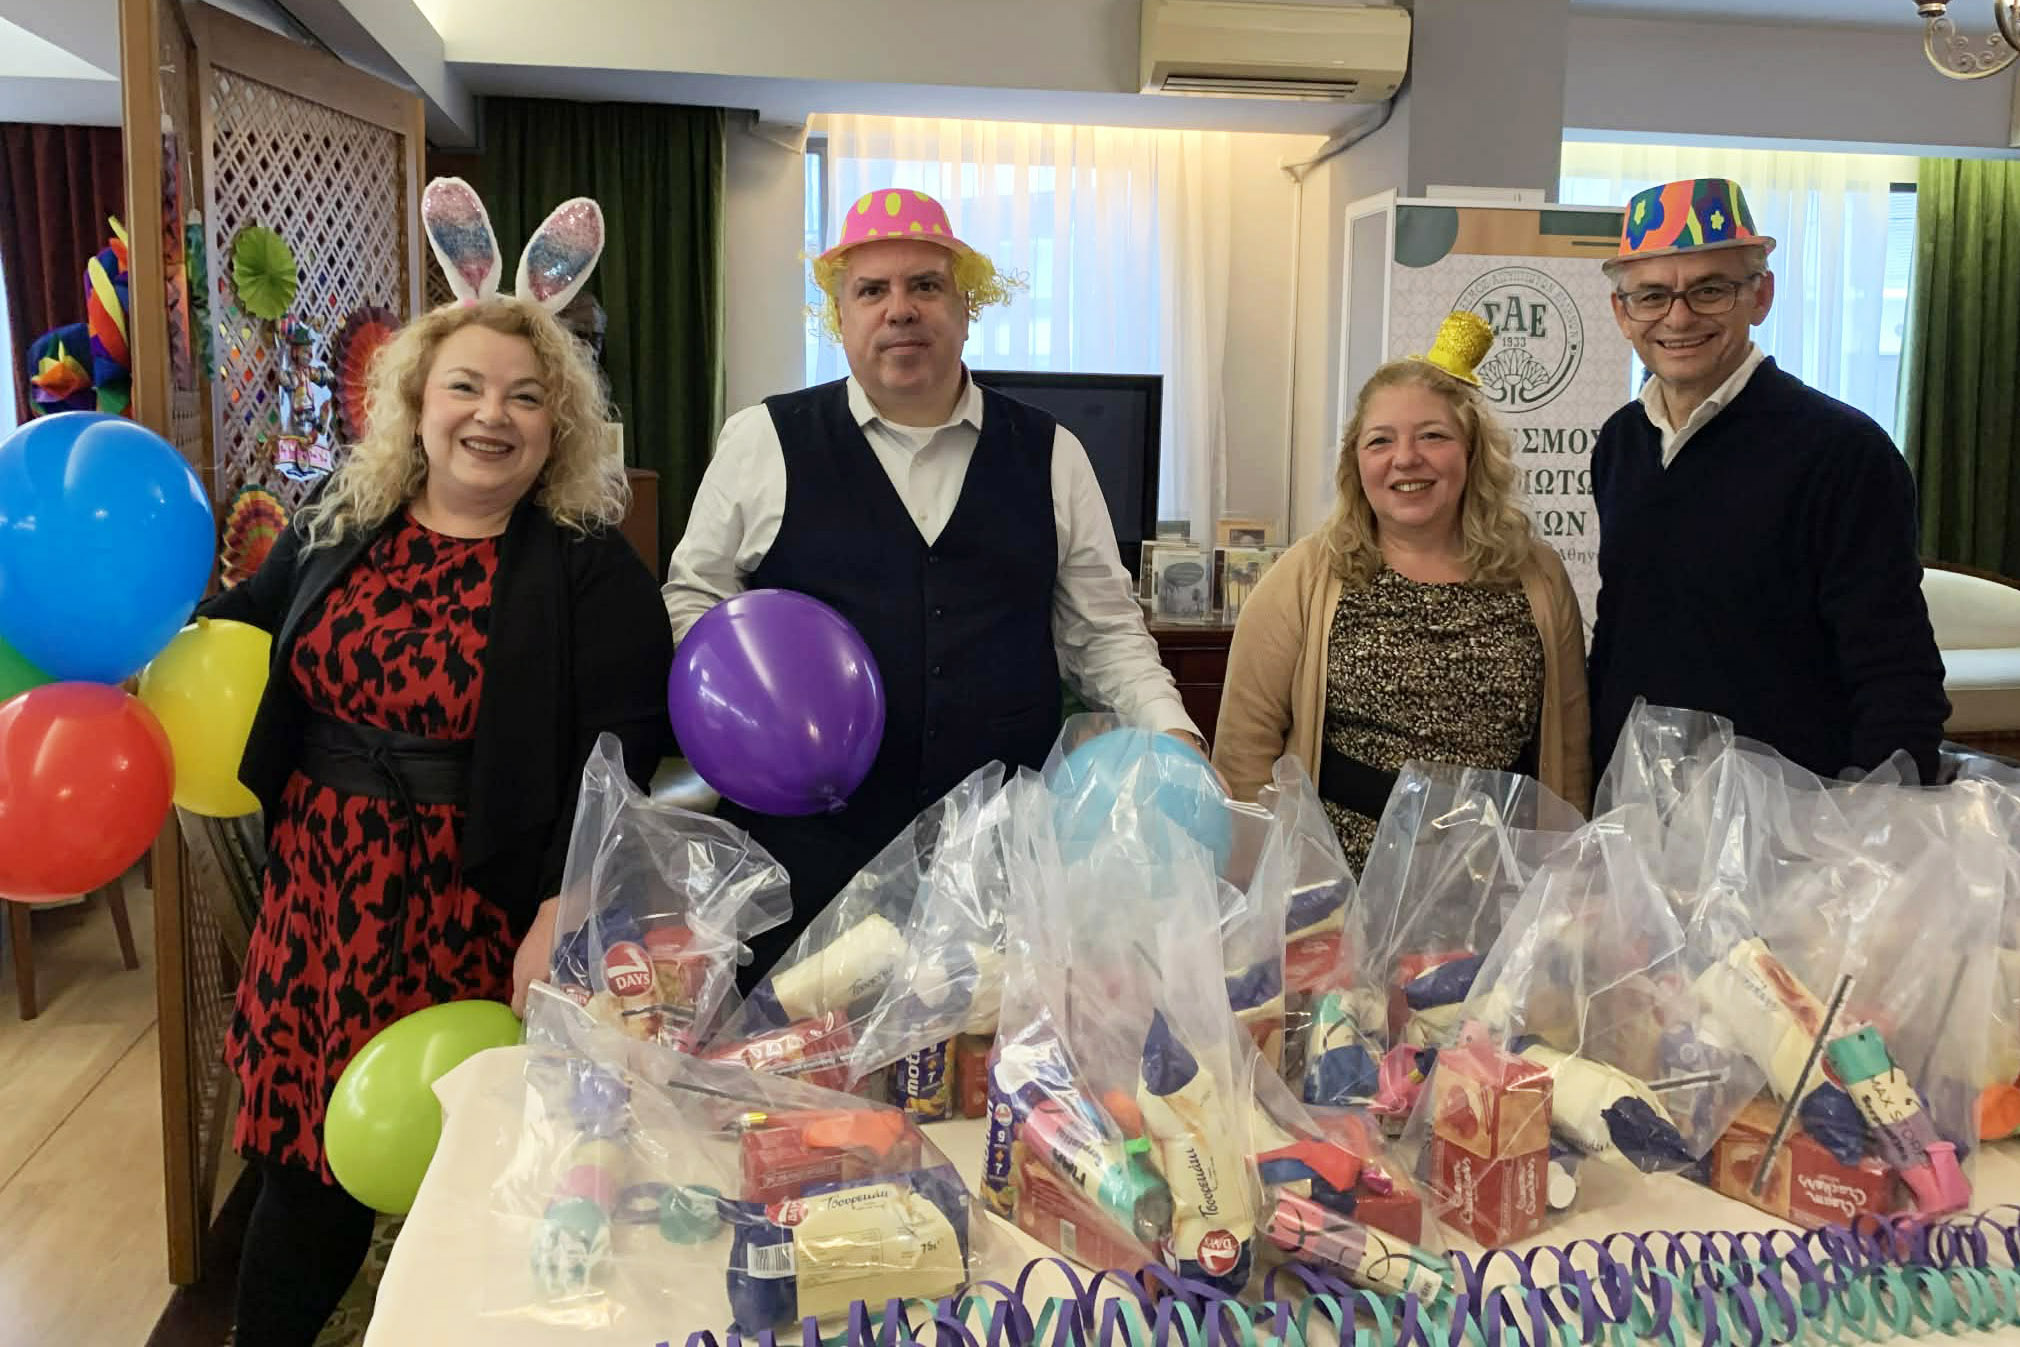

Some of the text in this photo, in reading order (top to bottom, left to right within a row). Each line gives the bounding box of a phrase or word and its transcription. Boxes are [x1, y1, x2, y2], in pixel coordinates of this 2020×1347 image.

[1483, 295, 1547, 338] ΣΑΕ
[1502, 337, 1527, 348] 1933
[1536, 510, 1587, 536] ΩΝ
[615, 973, 651, 991] DAYS
[996, 1130, 1006, 1142] 9
[995, 1163, 1004, 1175] 7
